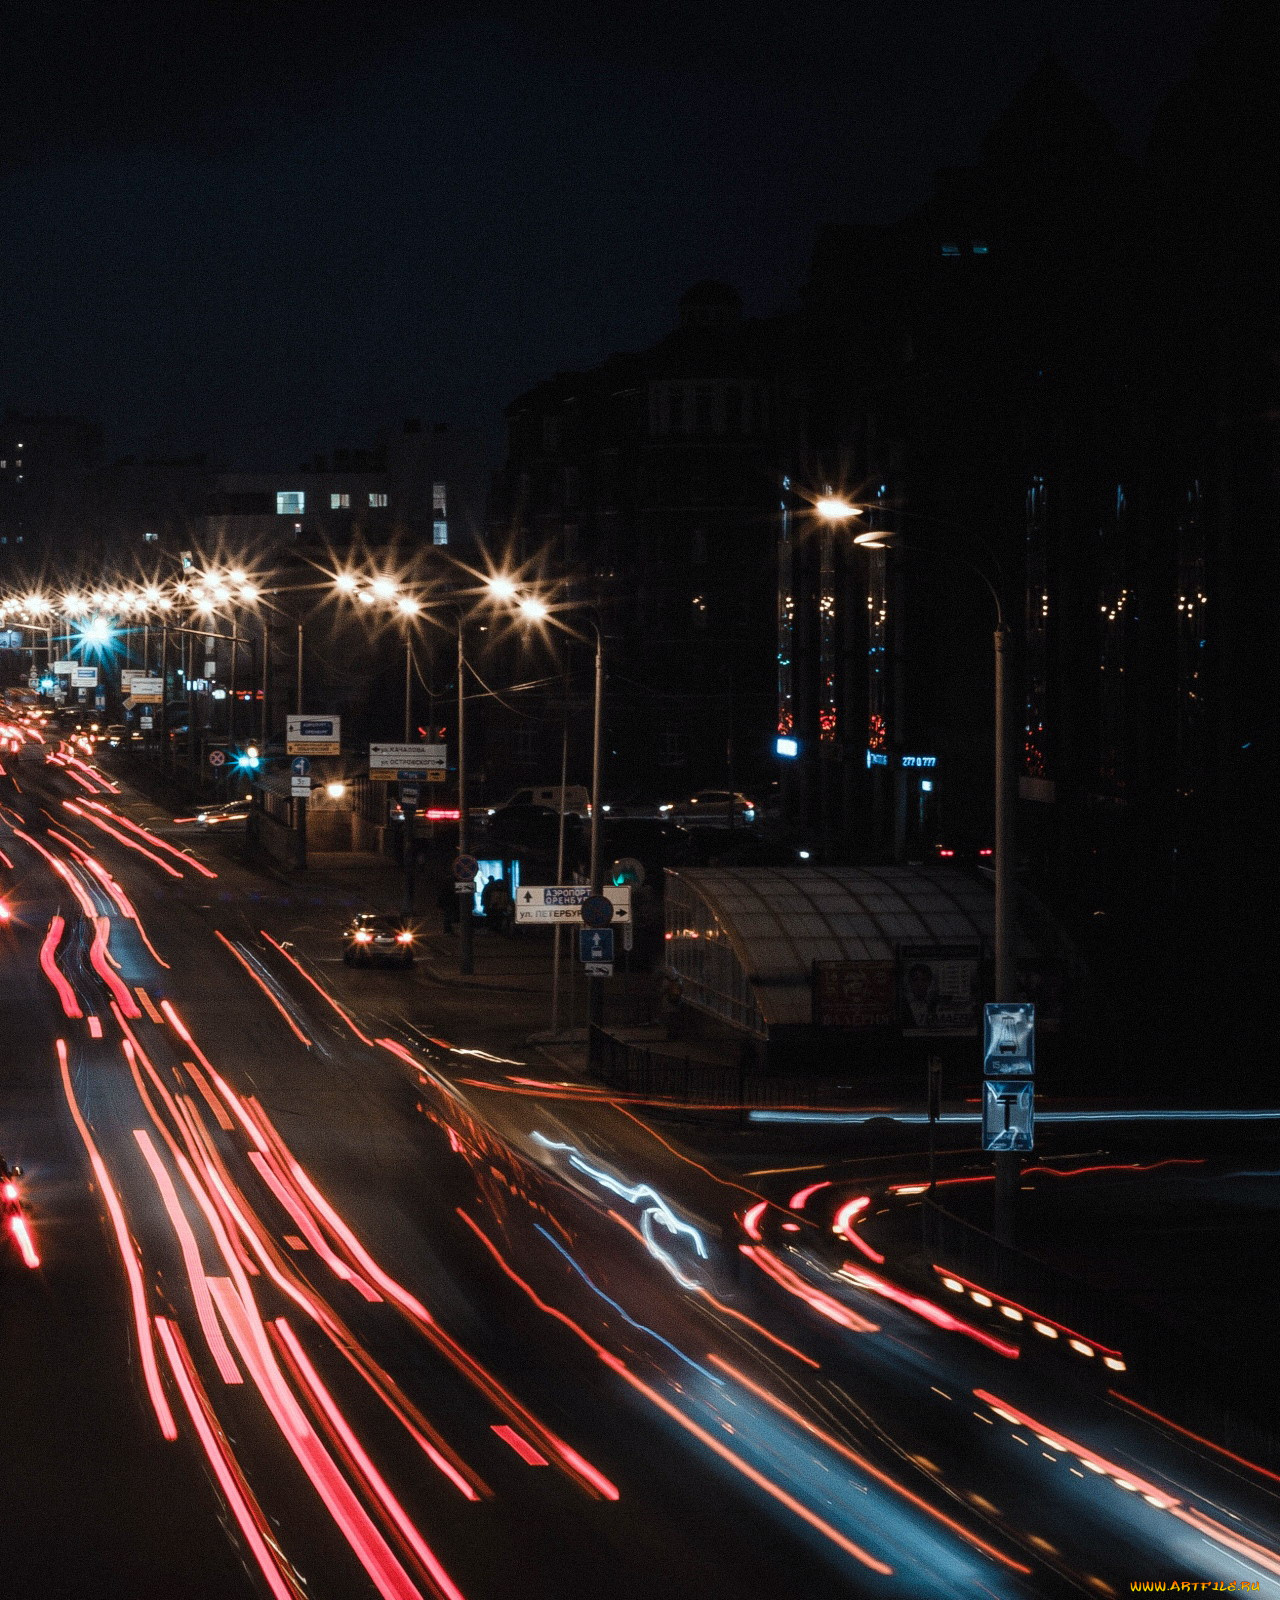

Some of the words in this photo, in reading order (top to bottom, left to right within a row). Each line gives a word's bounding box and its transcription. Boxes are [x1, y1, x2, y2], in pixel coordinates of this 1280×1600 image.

[902, 757, 915, 767] 277
[922, 757, 936, 767] 777
[545, 889, 592, 897] АЭРОПОРТ
